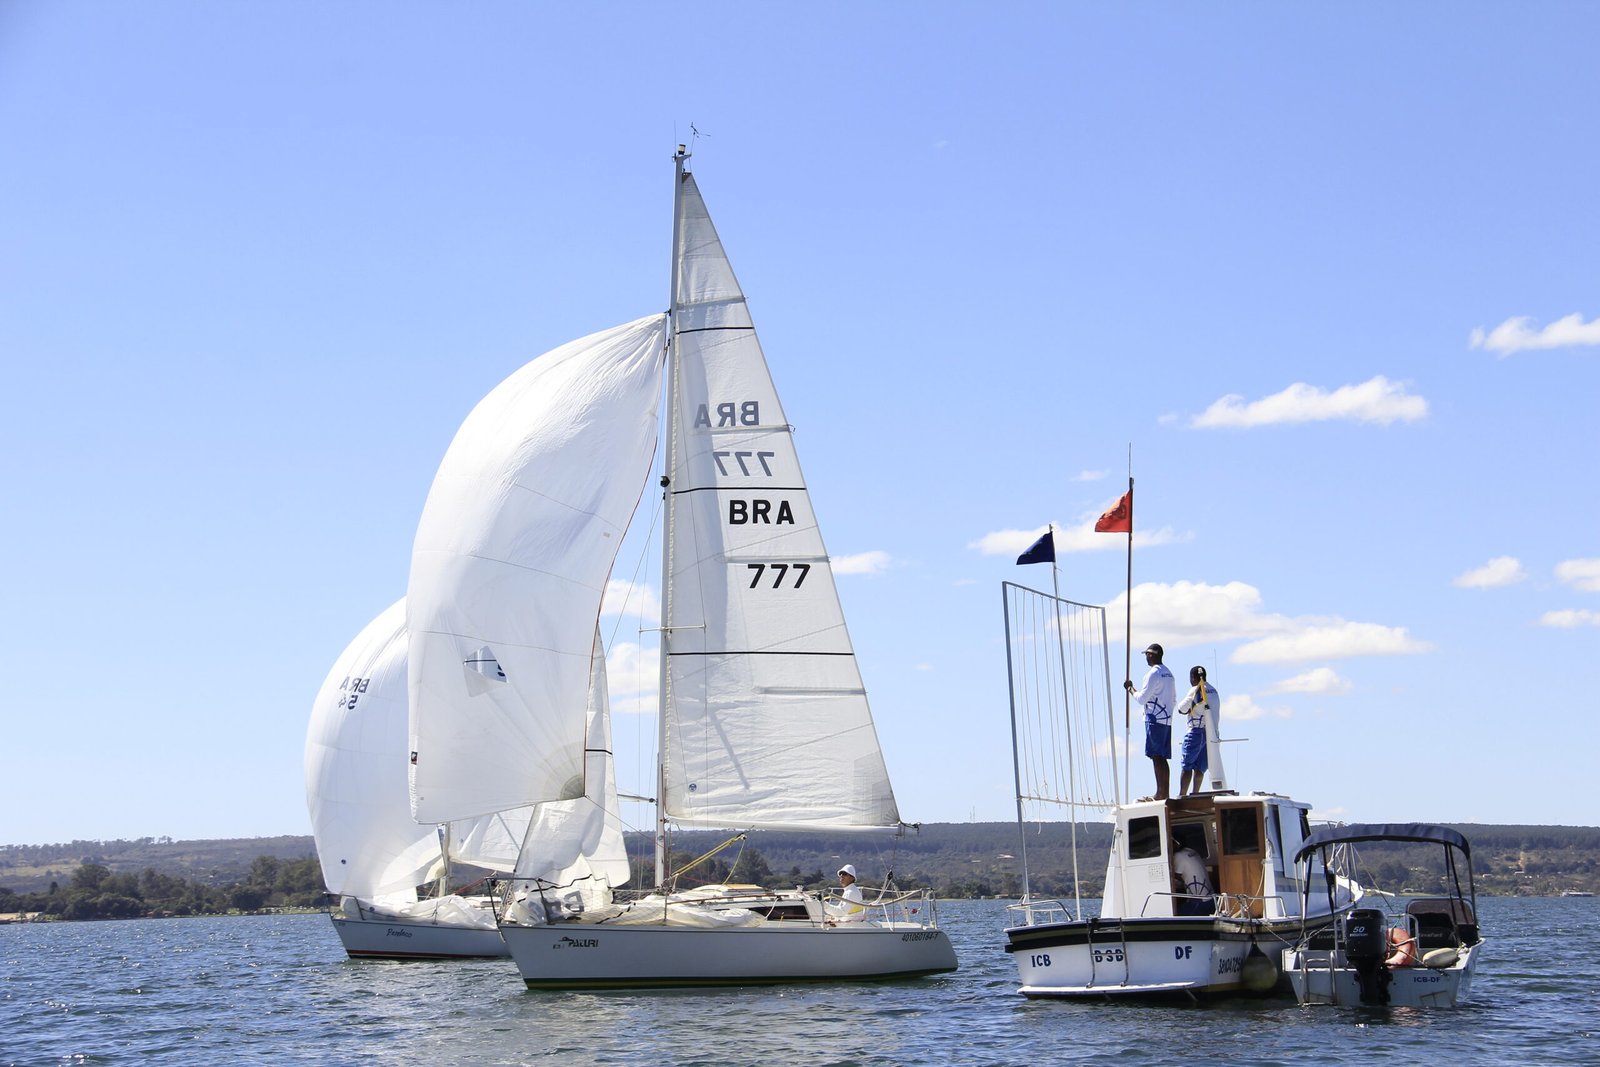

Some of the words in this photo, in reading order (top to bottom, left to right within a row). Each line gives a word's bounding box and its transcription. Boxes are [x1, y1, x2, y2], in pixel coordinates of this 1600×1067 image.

[729, 499, 795, 525] BRA
[747, 563, 811, 589] 777
[1031, 954, 1052, 967] ICB
[1094, 949, 1124, 963] BSB
[1174, 946, 1192, 960] DF
